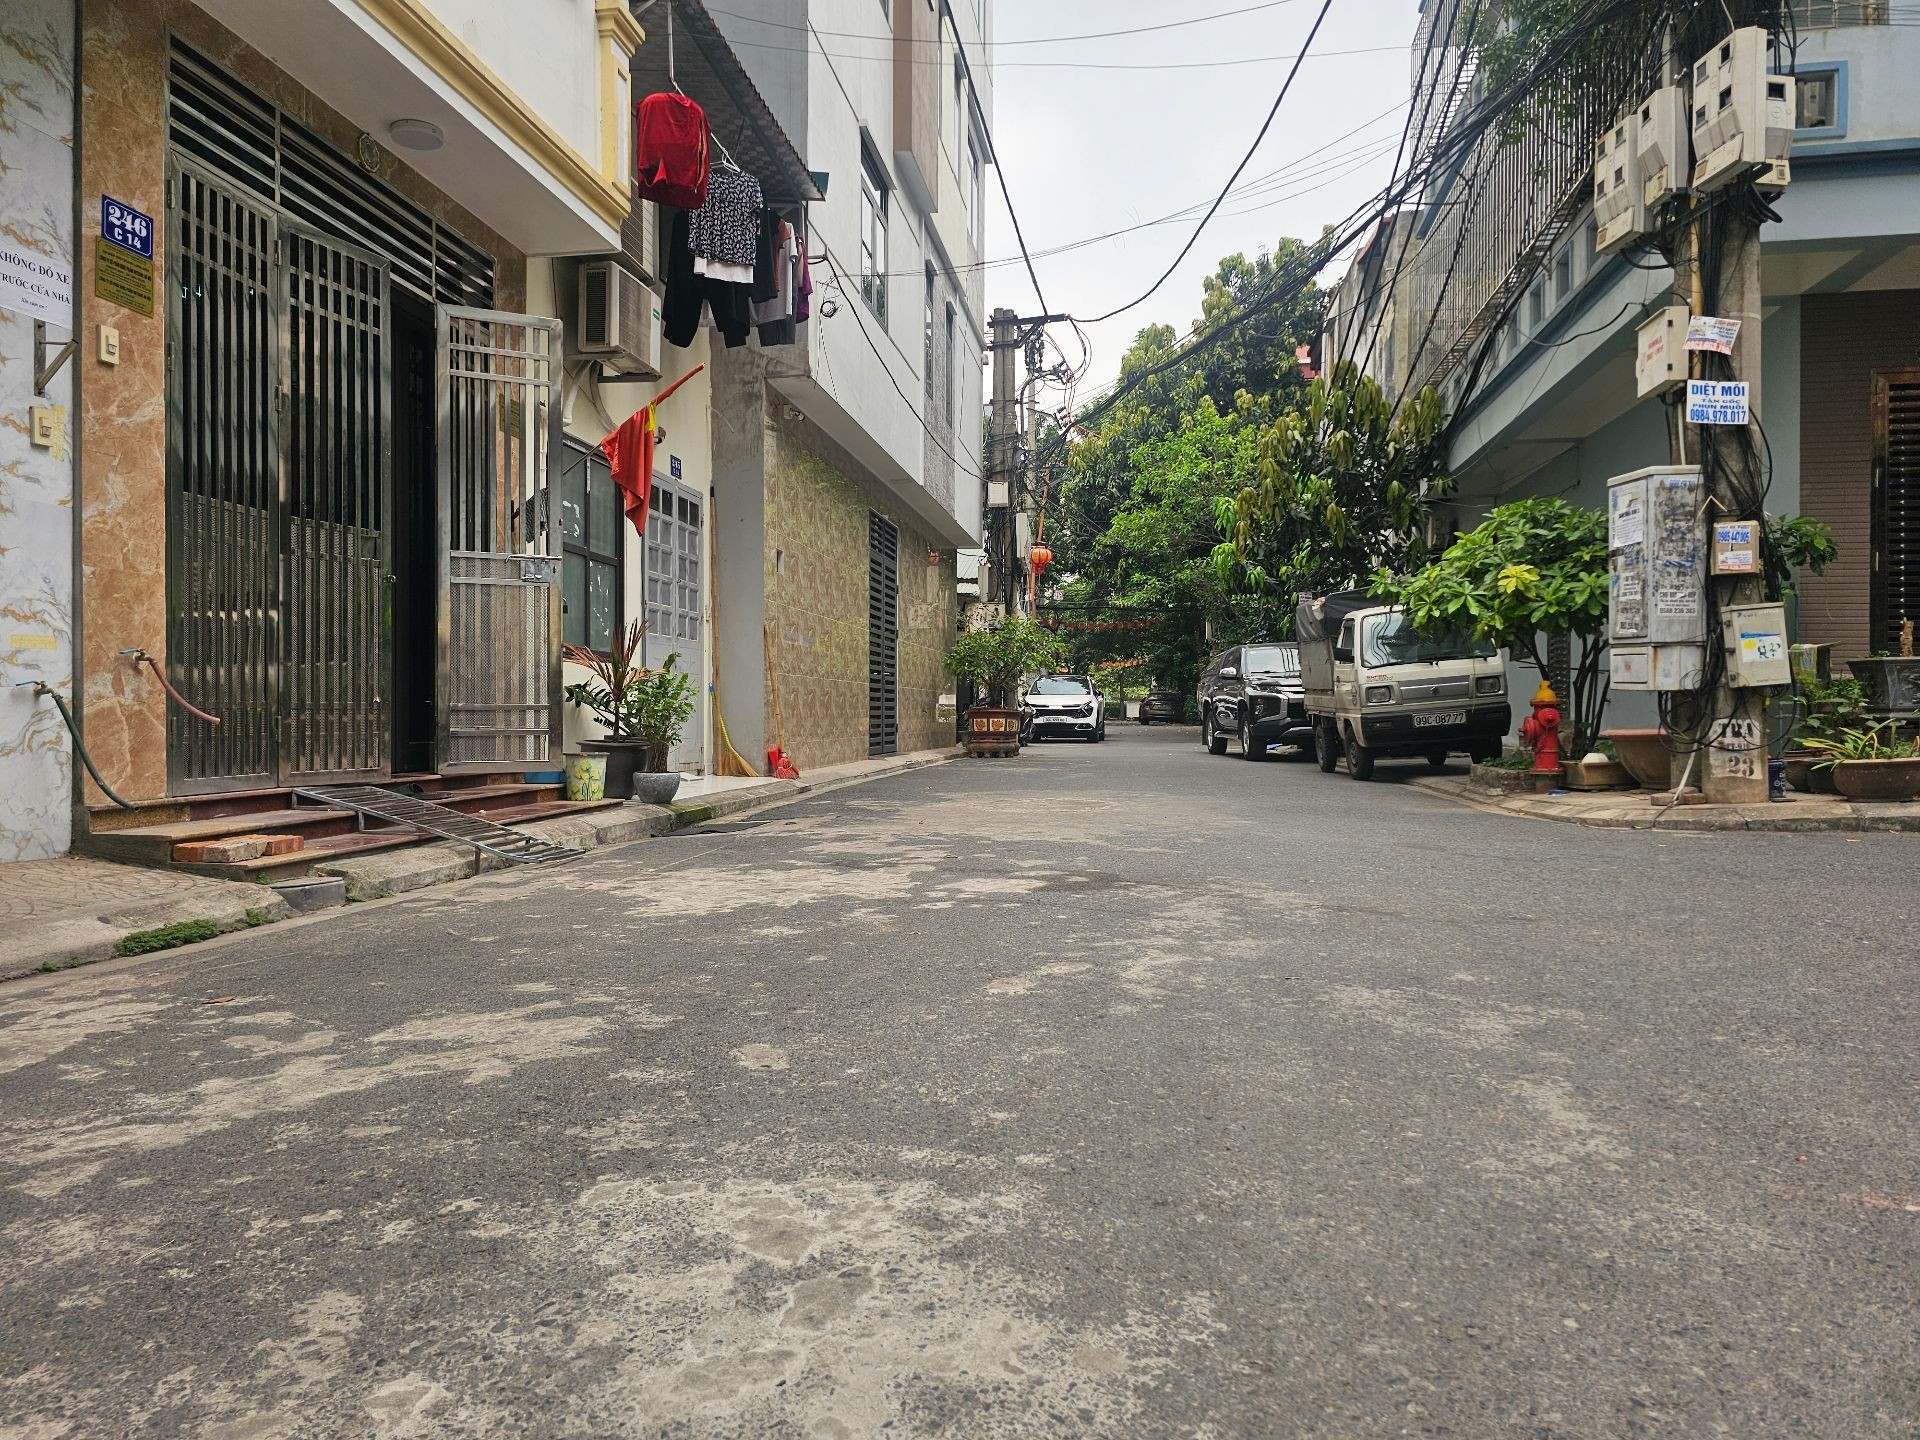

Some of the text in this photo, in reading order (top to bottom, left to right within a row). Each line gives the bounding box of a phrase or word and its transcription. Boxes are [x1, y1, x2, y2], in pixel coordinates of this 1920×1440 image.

[108, 205, 147, 237] 246
[114, 227, 142, 249] C 14
[56, 271, 70, 285] XE
[52, 290, 71, 305] NHÀ
[1691, 383, 1745, 398] DIỆT MỐI
[1690, 408, 1746, 423] 0984.978.017
[1728, 755, 1755, 777] 23
